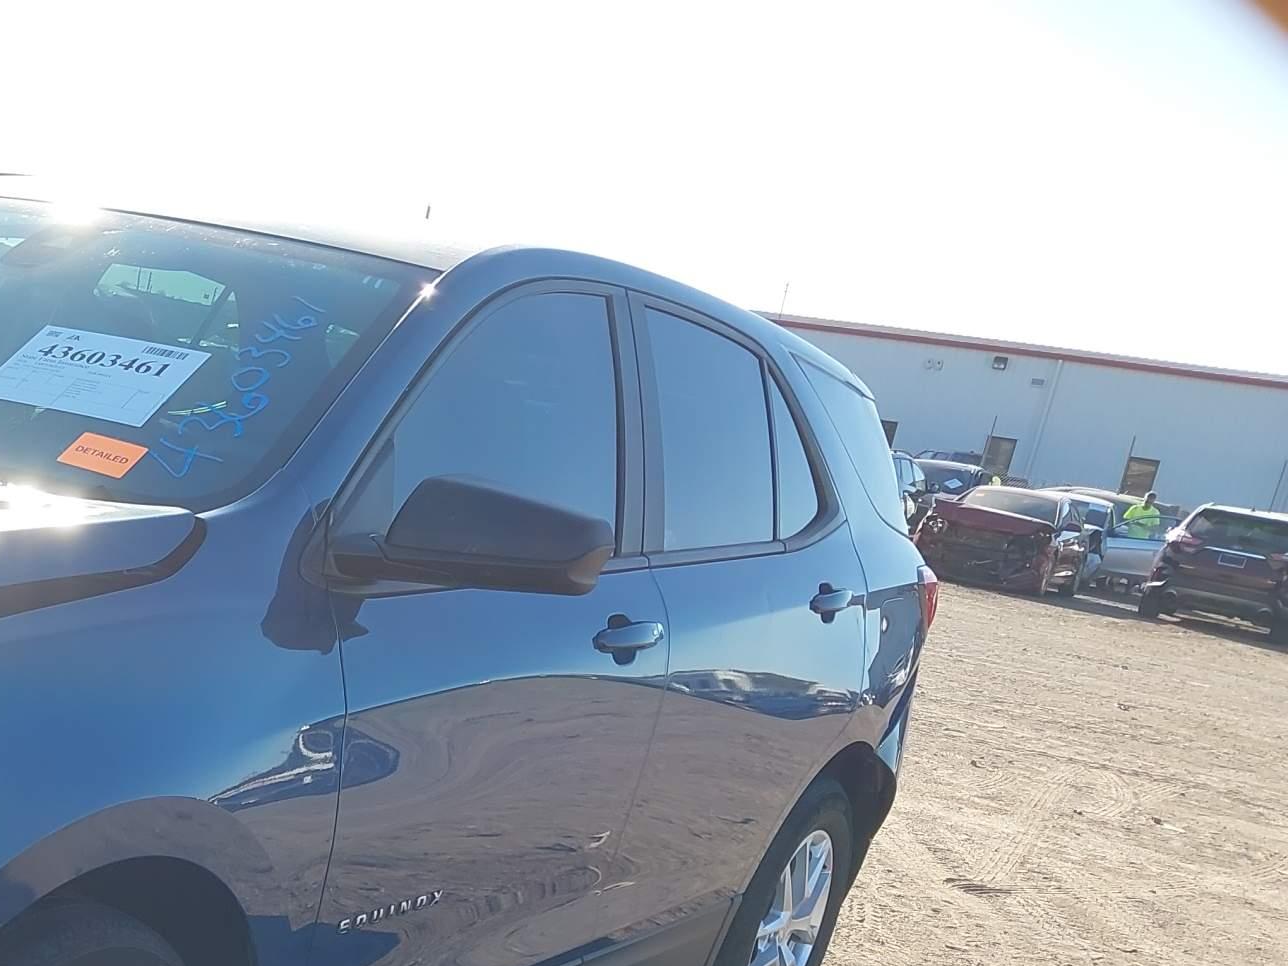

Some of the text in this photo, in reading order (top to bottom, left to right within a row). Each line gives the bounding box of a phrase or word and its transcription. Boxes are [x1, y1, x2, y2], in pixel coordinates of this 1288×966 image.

[38, 343, 171, 377] 43603461
[149, 295, 326, 478] 43603461
[75, 445, 129, 465] DETAILED
[339, 889, 443, 934] EQUINOX
